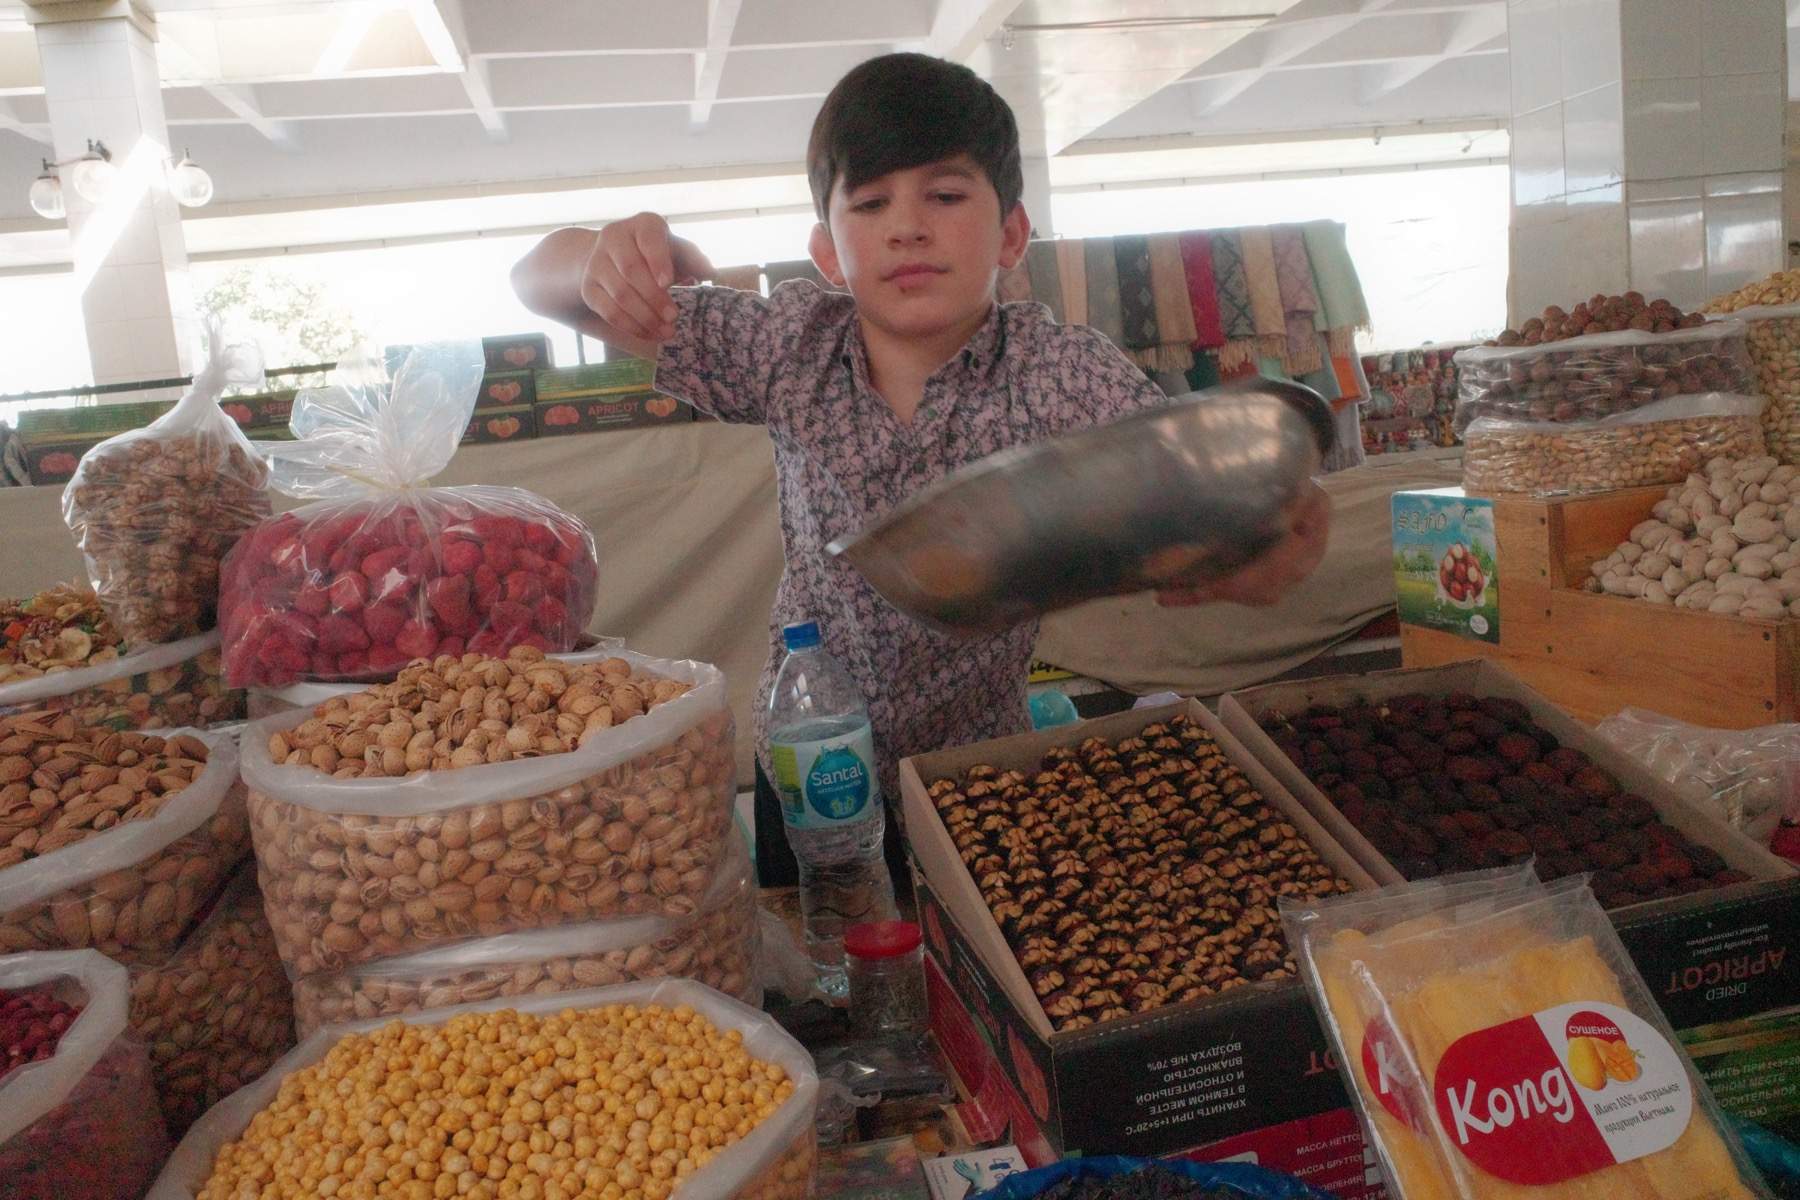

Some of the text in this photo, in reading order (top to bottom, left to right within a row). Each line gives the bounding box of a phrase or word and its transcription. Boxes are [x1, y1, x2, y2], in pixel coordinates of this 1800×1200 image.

[588, 401, 639, 416] APRICOT
[811, 762, 863, 786] Santal
[1664, 946, 1786, 994] APRICOT
[1705, 982, 1746, 1000] DRIED
[1568, 1025, 1619, 1036] СУШЕНОЕ
[1146, 1042, 1242, 1072] ВОЗДУХА Н/Б 70%
[1163, 1056, 1243, 1082] ВЛАЖНОСТЬЮ
[1135, 1070, 1245, 1104] И ОТНОСИТЕЛЬНОЙ
[1148, 1084, 1246, 1116] В ТЕМНОМ МЕСТЕ
[1197, 1098, 1247, 1118] ХРАНИТЬ
[1446, 1067, 1575, 1145] Kong
[1171, 1111, 1195, 1123] ПРИ
[1296, 1141, 1328, 1155] МАССА
[1293, 1163, 1325, 1177] МАССА
